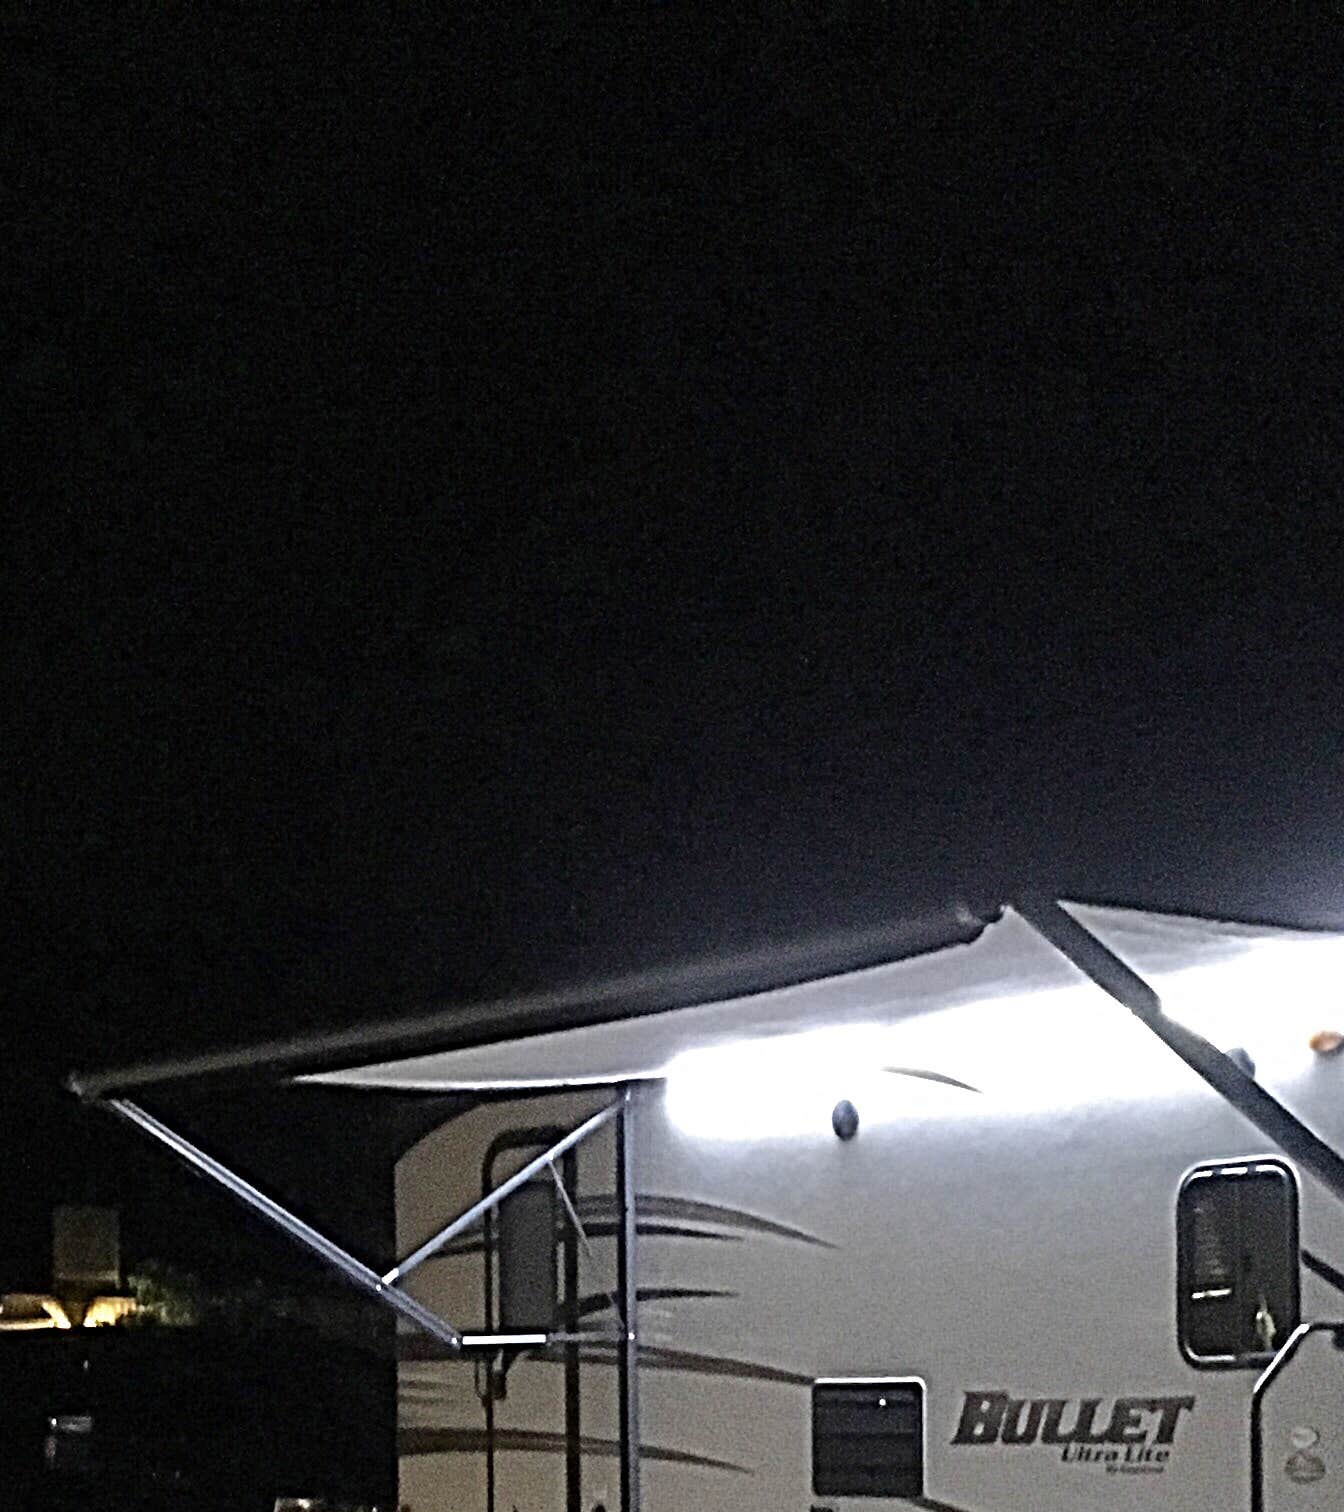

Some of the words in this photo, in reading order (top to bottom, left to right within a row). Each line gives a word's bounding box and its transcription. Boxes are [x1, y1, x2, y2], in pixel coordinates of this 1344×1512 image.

[950, 1390, 1196, 1444] BULLET
[1061, 1446, 1119, 1462] Ultra
[1124, 1446, 1170, 1462] Lite
